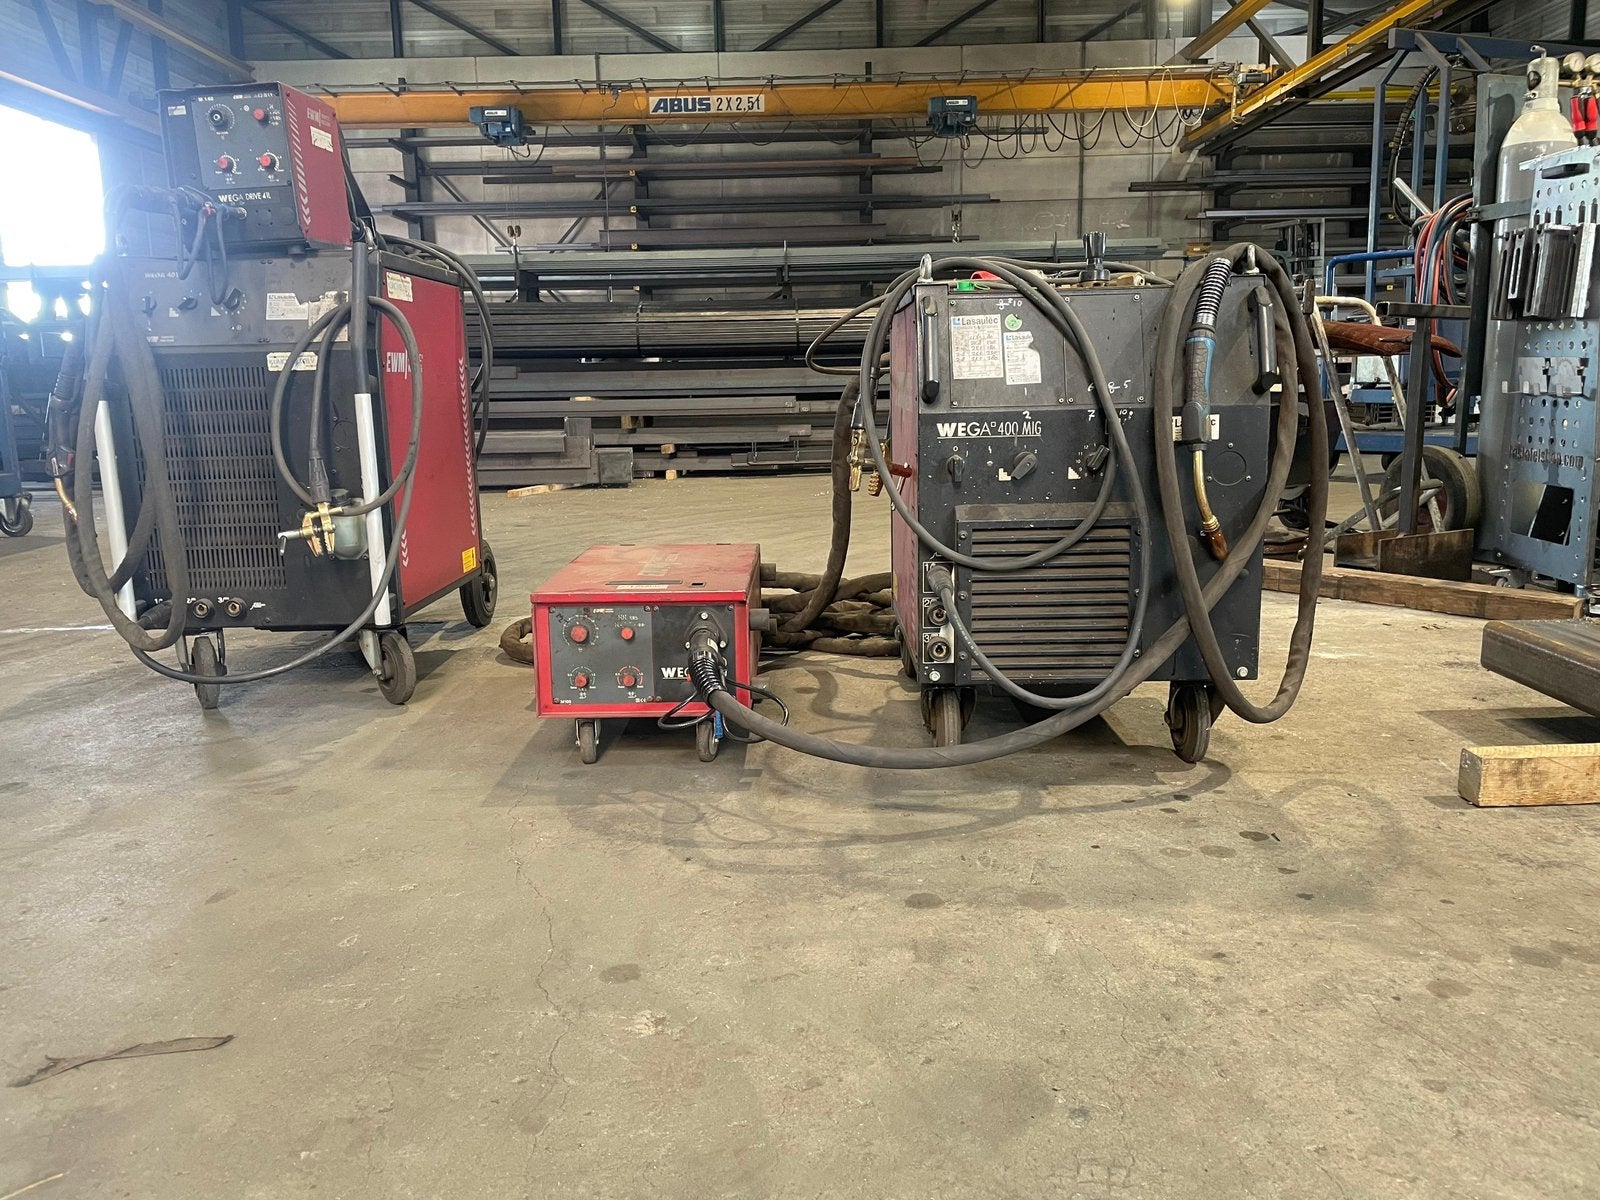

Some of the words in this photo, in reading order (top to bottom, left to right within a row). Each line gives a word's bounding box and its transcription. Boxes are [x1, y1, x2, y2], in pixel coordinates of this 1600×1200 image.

[652, 97, 711, 113] ABUS
[716, 97, 723, 111] 2
[726, 97, 732, 111] X
[218, 194, 244, 203] WEGA
[245, 192, 262, 201] DRIVE
[386, 352, 405, 373] EWM
[1022, 410, 1032, 420] 2
[936, 422, 992, 438] WEGA
[998, 421, 1019, 436] 400
[1022, 420, 1042, 436] MIG
